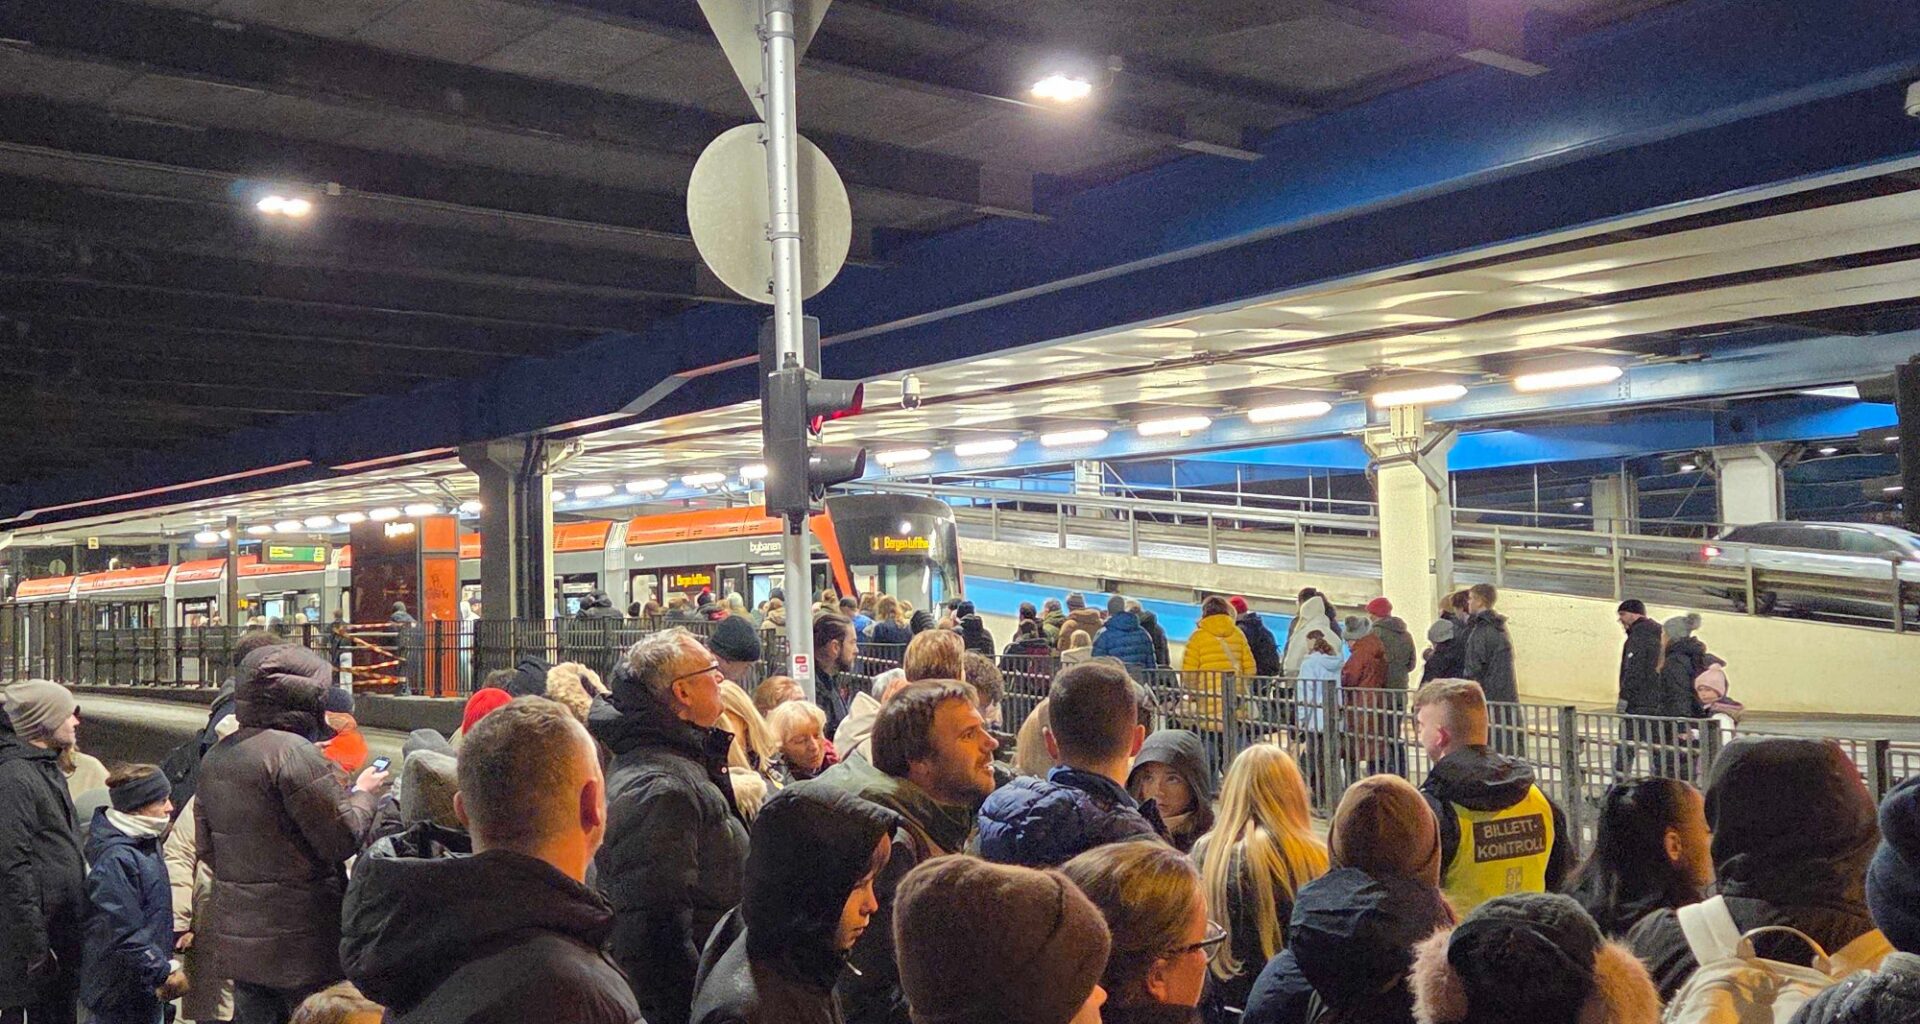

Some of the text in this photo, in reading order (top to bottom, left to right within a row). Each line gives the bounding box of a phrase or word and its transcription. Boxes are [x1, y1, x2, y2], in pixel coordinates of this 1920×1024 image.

[749, 541, 781, 554] bybanen
[873, 537, 880, 551] 1
[884, 536, 907, 552] Bergen
[1483, 819, 1538, 839] BILLETT-
[1477, 837, 1545, 858] KONTROLL
